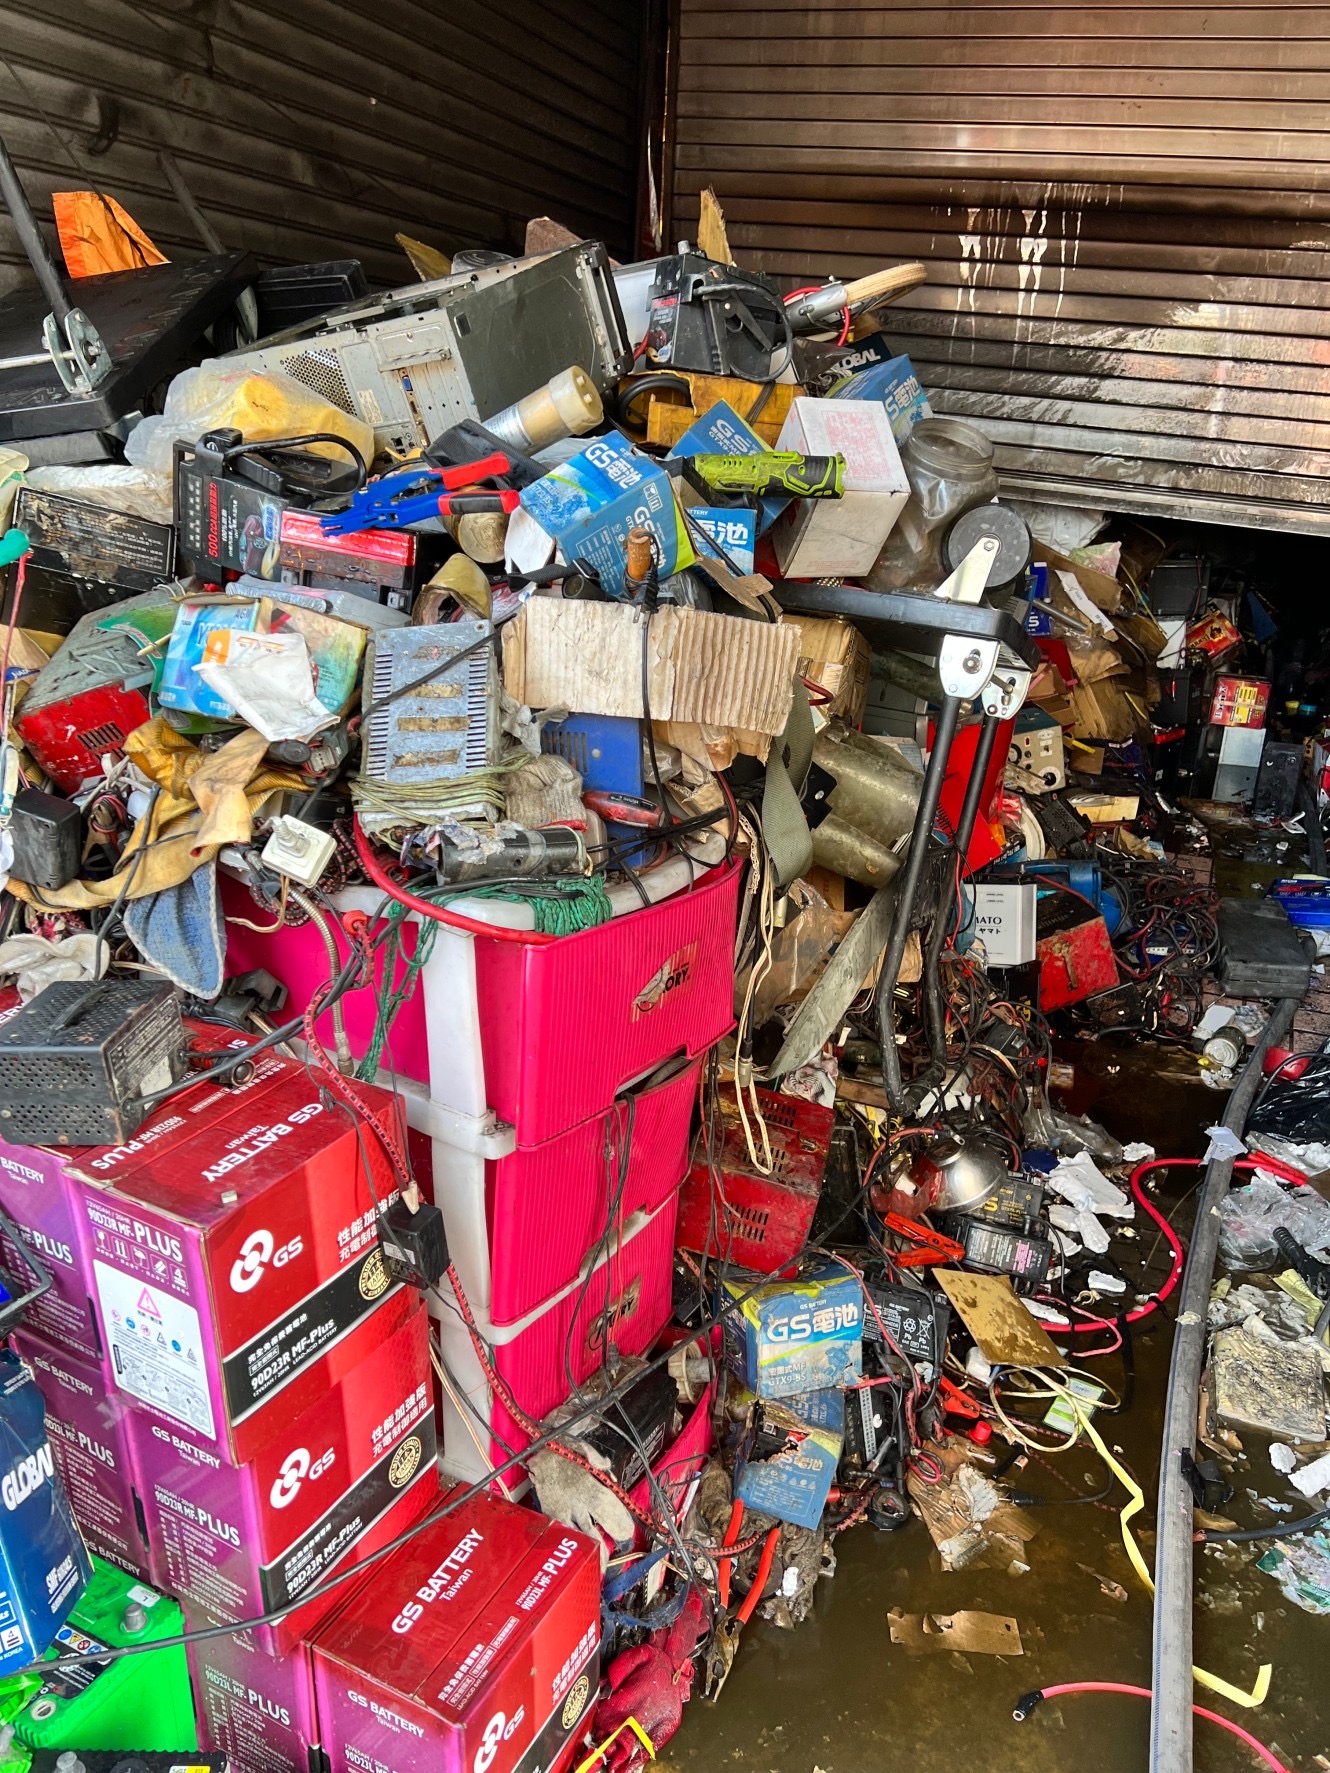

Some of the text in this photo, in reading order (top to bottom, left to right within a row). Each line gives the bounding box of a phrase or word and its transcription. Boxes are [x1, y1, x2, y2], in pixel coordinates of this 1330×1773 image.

[884, 375, 920, 420] S電池
[585, 443, 643, 489] GS電池
[691, 519, 748, 545] 電池
[975, 916, 1002, 924] MATO
[91, 1140, 145, 1170] PLUS
[200, 1103, 324, 1183] GS BATTERY
[225, 1124, 270, 1150] Taiwan
[0, 1156, 45, 1184] BATTERY
[337, 1189, 400, 1246] 性能加強版
[33, 1230, 73, 1264] PLUS
[133, 1221, 183, 1262] PLUS
[273, 1235, 304, 1268] GS
[767, 1302, 859, 1343] GS電池
[251, 1318, 335, 1390] 90D23R MF-Plus
[34, 1356, 50, 1372] GS
[51, 1365, 94, 1396] BATTERY
[371, 1381, 427, 1443] 性能加強版
[78, 1431, 116, 1468] PLUS
[152, 1426, 221, 1469] GS BATTERY
[178, 1449, 201, 1467] Taiwan
[309, 1447, 336, 1480] GS
[197, 1508, 240, 1547] PLUS
[98, 1544, 140, 1577] BATTERY
[287, 1516, 361, 1593] 90D23R MF-Plus
[545, 1537, 578, 1576] PLUS
[391, 1527, 484, 1634] GS BATTERY
[440, 1568, 474, 1602] Taiwan
[232, 1635, 255, 1653] Taiwan
[248, 1689, 290, 1726] PLUS
[347, 1690, 425, 1738] GS BATTERY
[376, 1715, 401, 1734] Taiwan
[503, 1704, 525, 1741] GS
